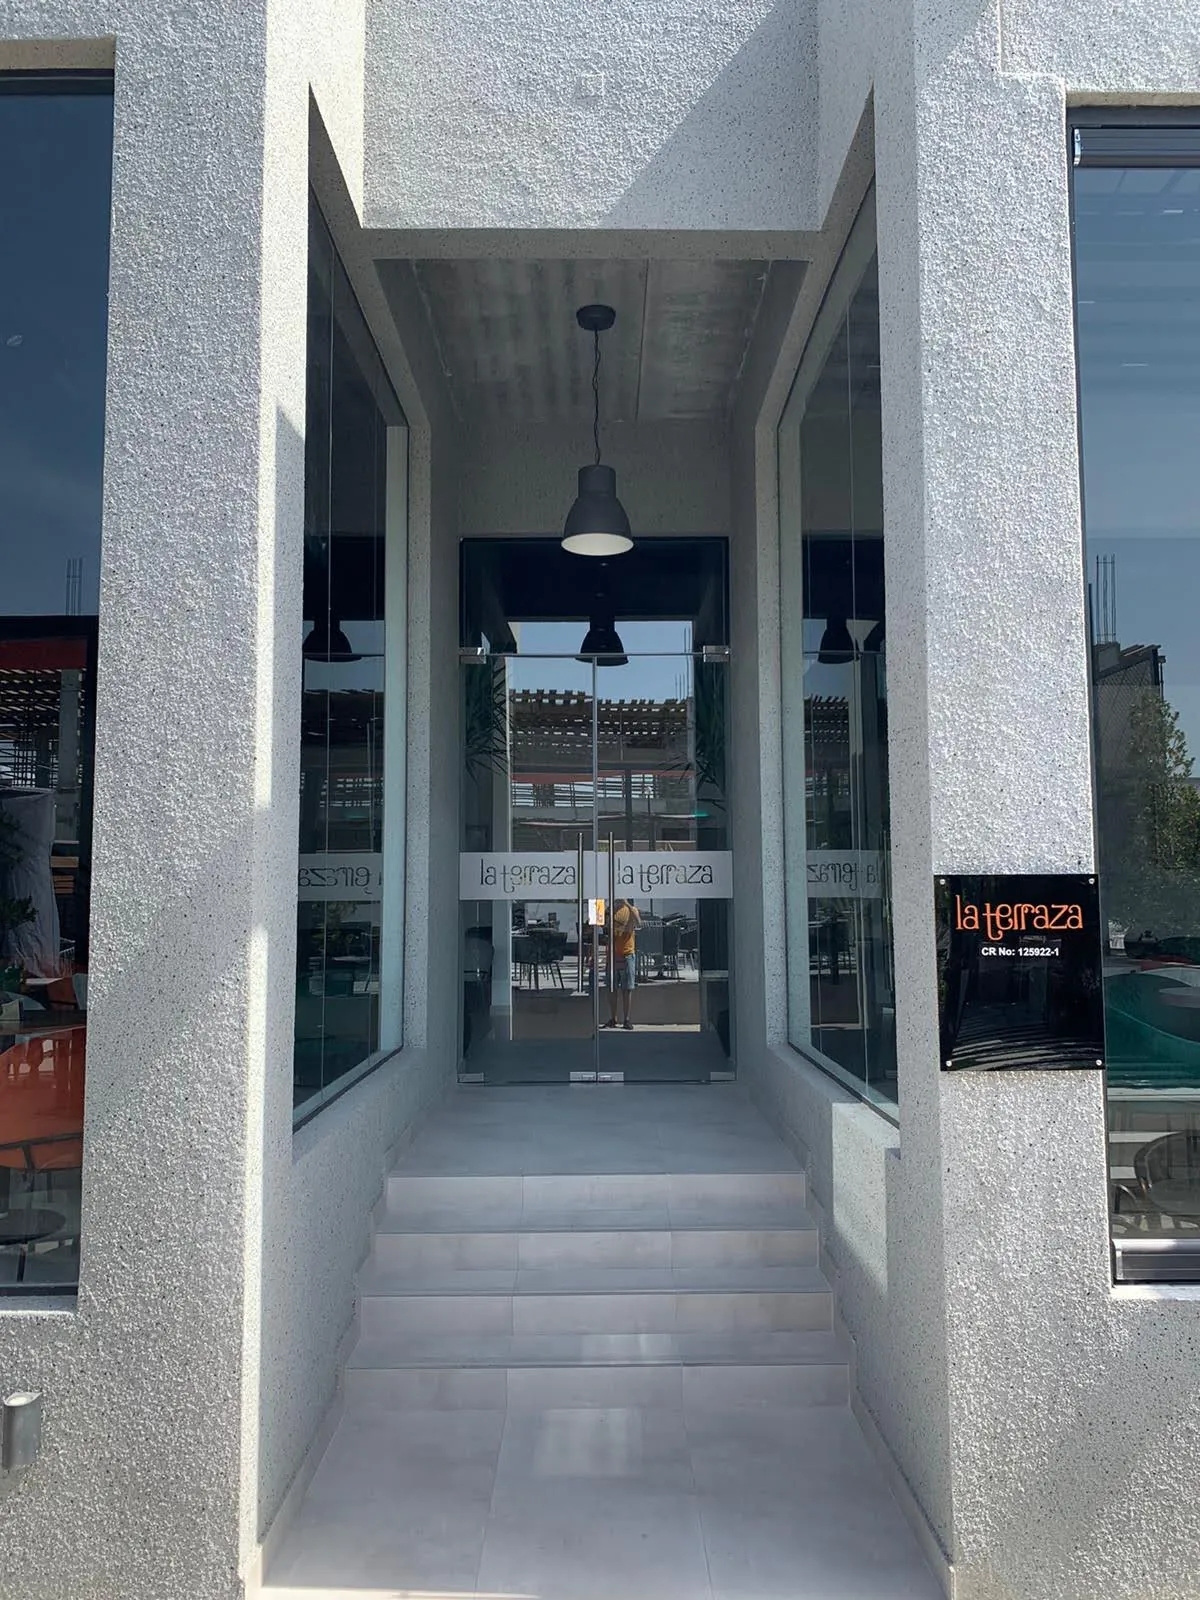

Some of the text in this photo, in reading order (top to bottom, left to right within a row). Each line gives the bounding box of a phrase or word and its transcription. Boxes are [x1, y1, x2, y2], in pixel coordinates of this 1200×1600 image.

[480, 858, 577, 893] la terraza
[617, 857, 713, 892] la terraza
[955, 895, 1083, 941] la terraza
[981, 947, 1059, 957] CR No: 125922-1
